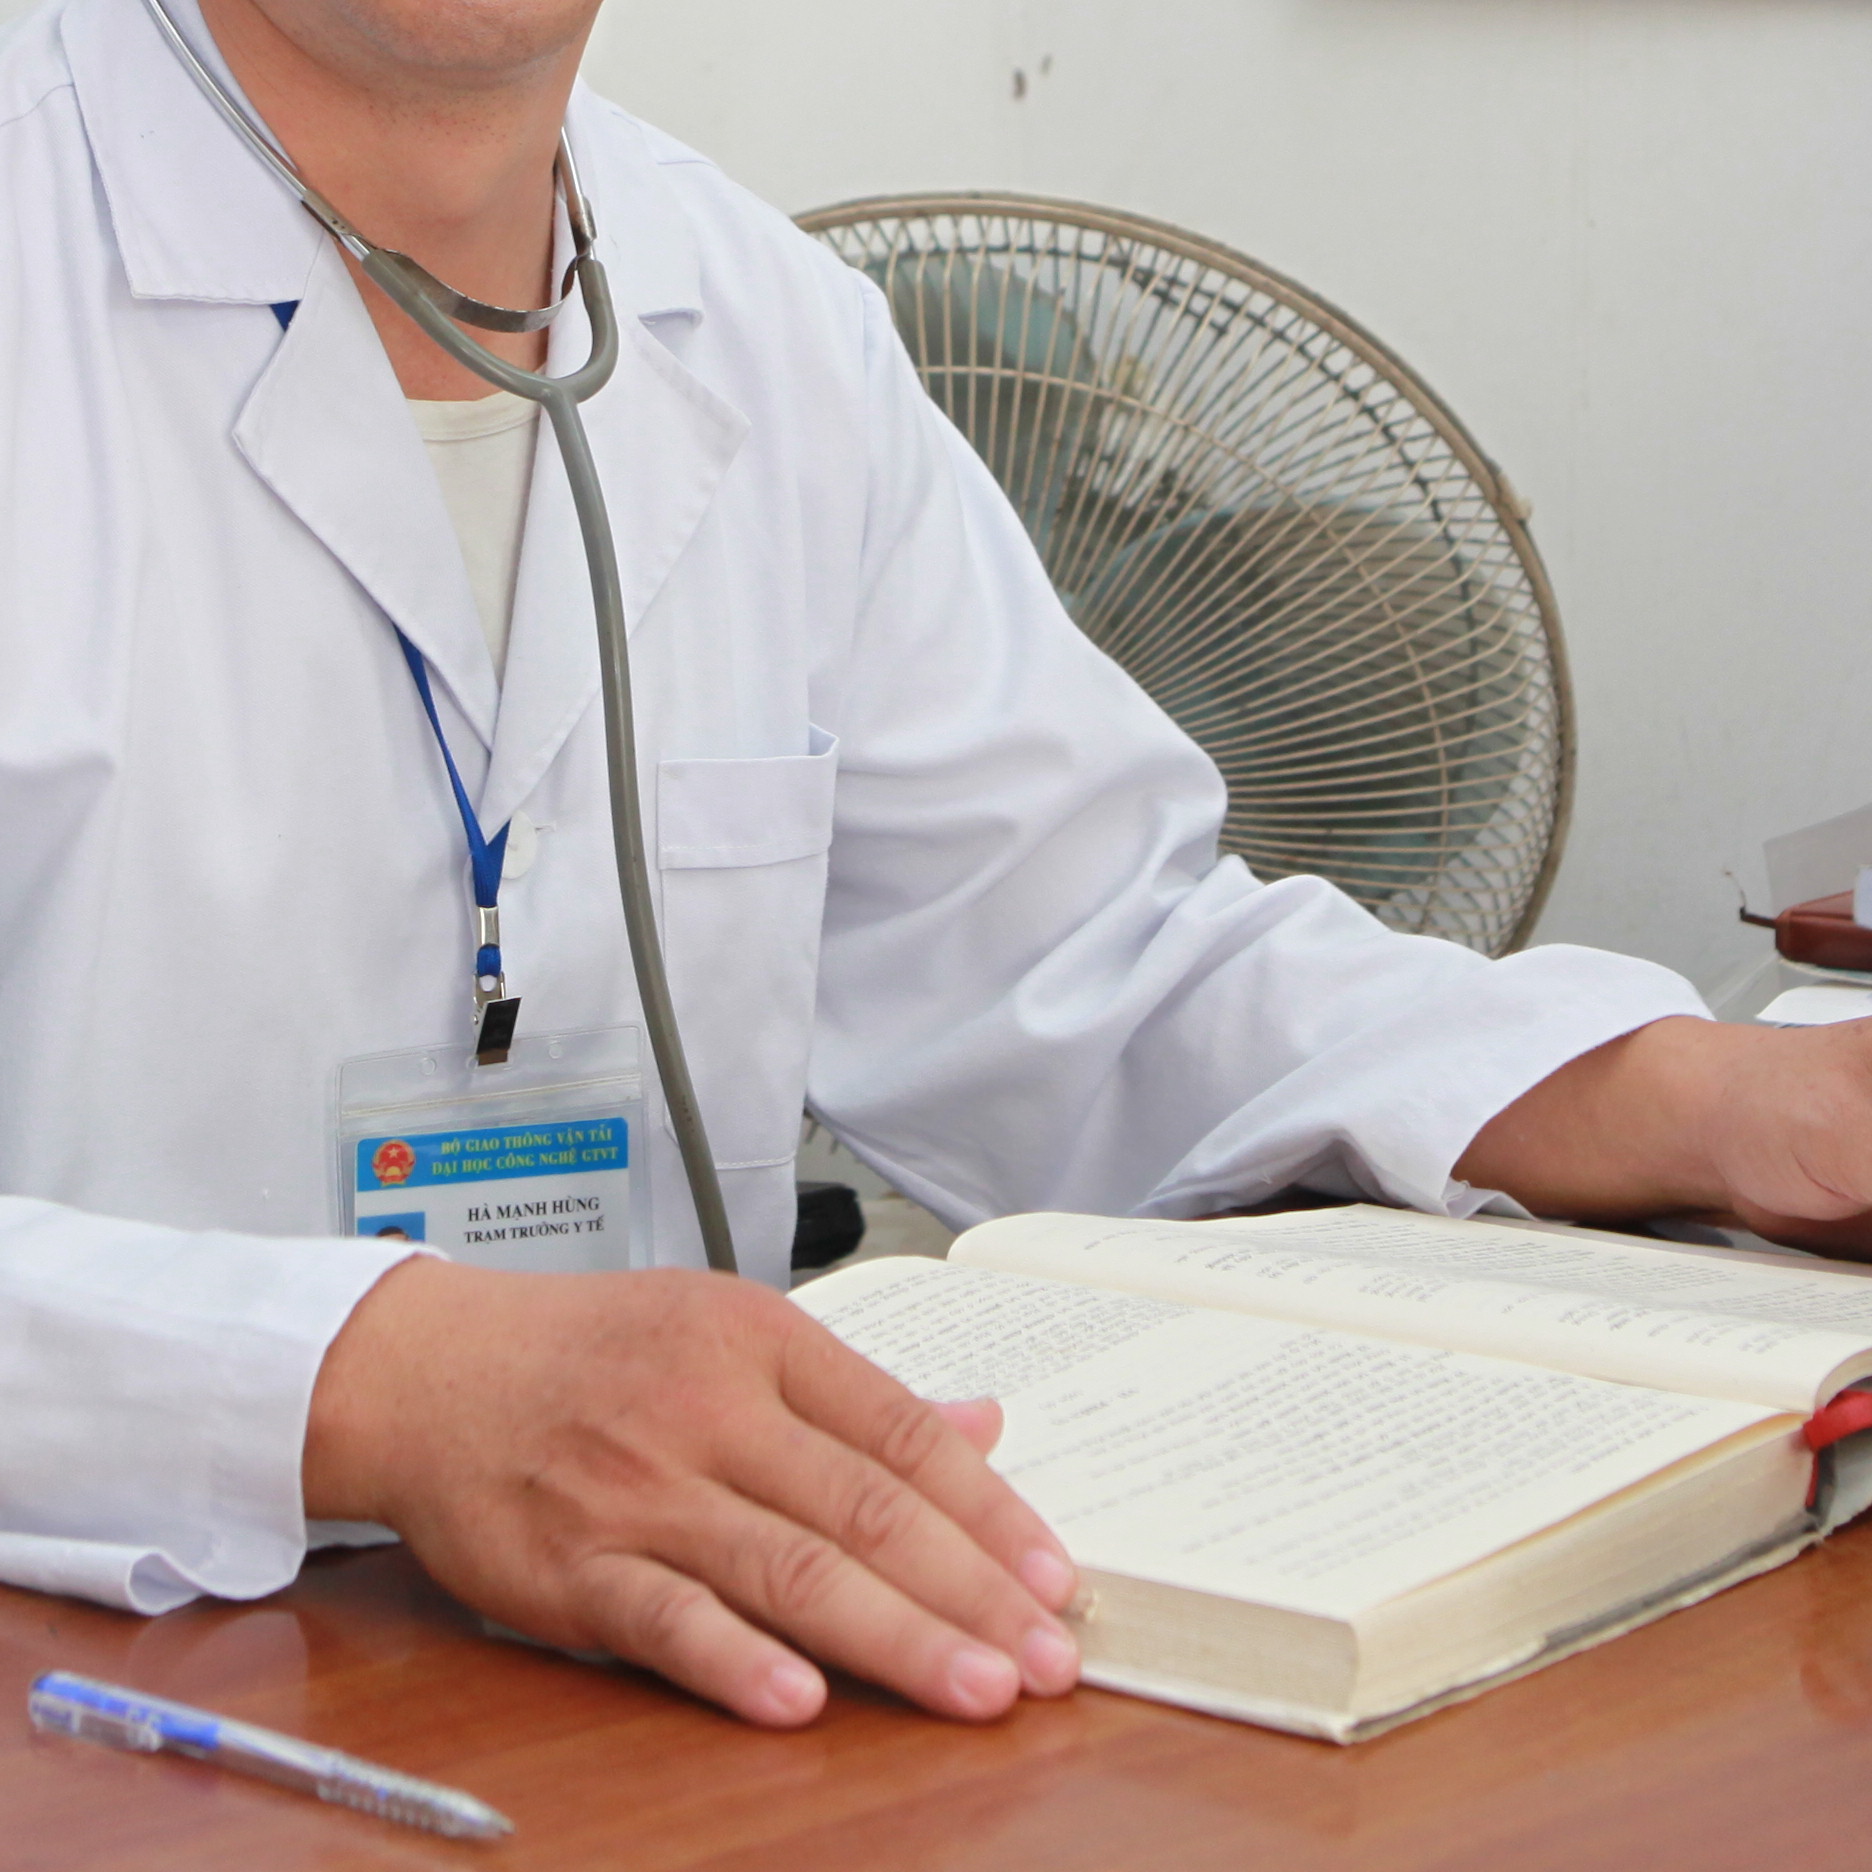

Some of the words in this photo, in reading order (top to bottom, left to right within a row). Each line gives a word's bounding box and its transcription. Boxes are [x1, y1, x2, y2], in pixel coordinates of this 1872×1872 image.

[441, 1138, 461, 1156] BỘ
[465, 1138, 500, 1152] GIAO
[504, 1132, 552, 1148] THÔNG
[556, 1129, 585, 1146] VẬN
[588, 1124, 612, 1141] TẢI
[432, 1161, 457, 1176] ĐẠI
[462, 1158, 492, 1174] HỌC
[496, 1153, 534, 1169] CÔNG
[539, 1149, 577, 1165] NGHỆ
[582, 1146, 618, 1161] GTVT
[468, 1203, 491, 1222] HÀ
[497, 1201, 547, 1221] MẠNH
[552, 1195, 600, 1213] HÙNG
[464, 1229, 506, 1245] TRẠM
[510, 1221, 569, 1240] TRƯỜNG
[574, 1222, 583, 1233] Y
[586, 1215, 605, 1232] TẾ
